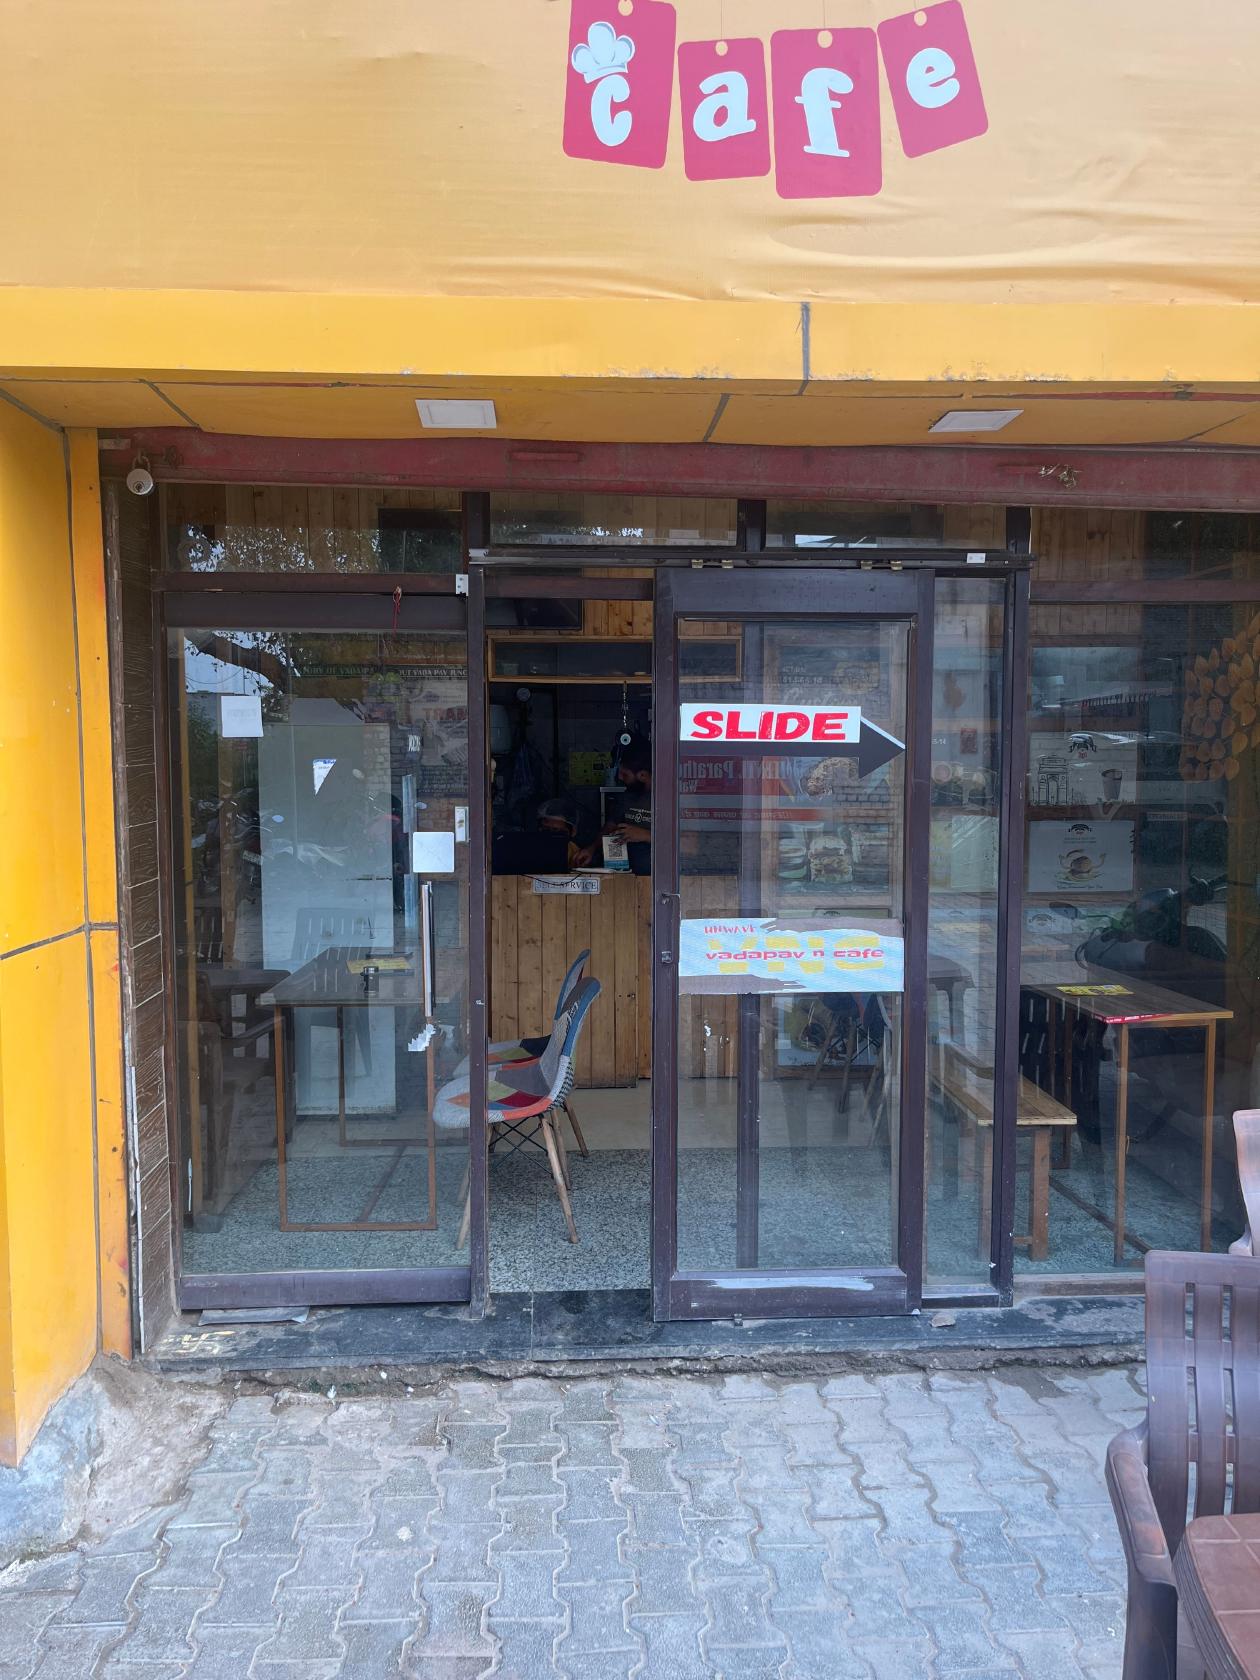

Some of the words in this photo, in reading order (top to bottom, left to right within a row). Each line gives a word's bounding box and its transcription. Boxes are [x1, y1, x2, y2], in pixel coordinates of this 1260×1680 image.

[590, 47, 960, 158] cafe
[690, 710, 849, 741] SLIDE
[706, 949, 805, 961] vadapav
[833, 948, 885, 959] cafe
